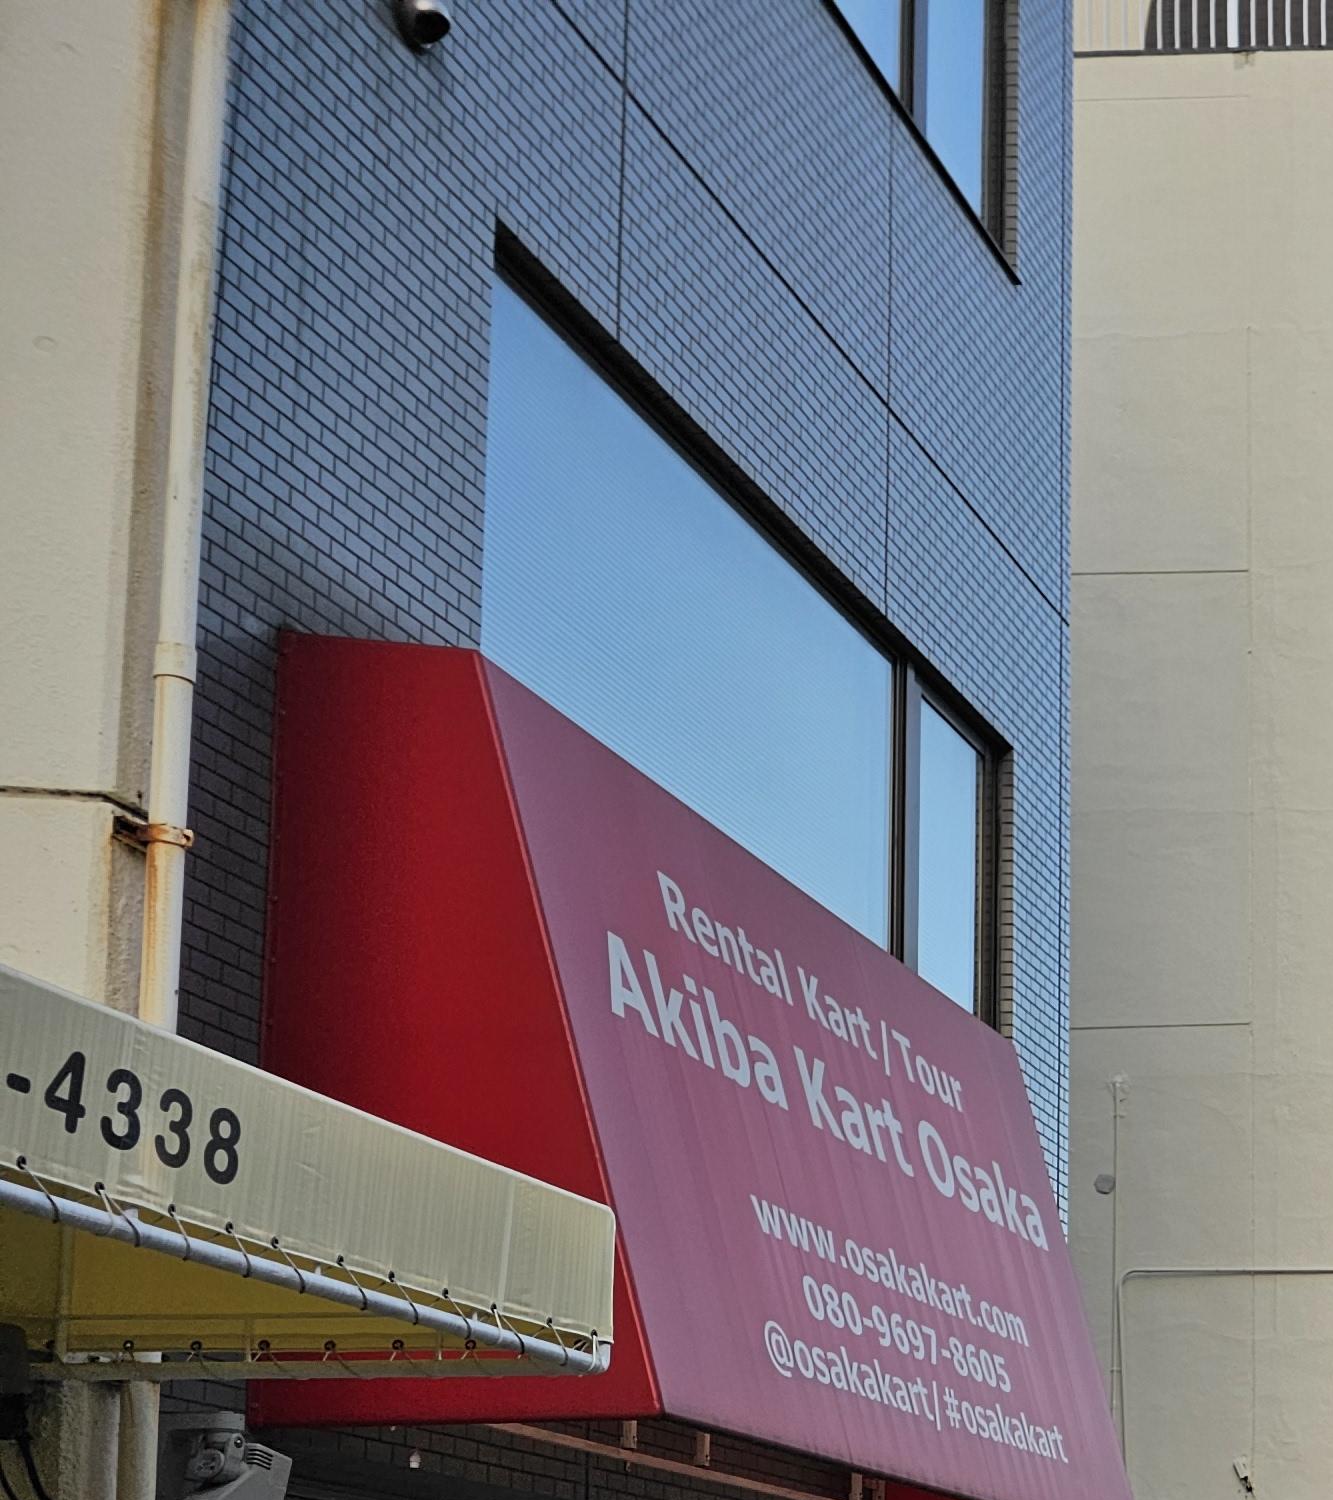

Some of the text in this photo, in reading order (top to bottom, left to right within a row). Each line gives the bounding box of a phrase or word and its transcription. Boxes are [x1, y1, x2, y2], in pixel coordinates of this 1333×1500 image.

[657, 870, 793, 1006] Rental
[797, 965, 878, 1060] Kart
[891, 1029, 964, 1112] Tour
[7, 1051, 241, 1185] -4338
[607, 930, 1049, 1252] Akiba Kart Osaka
[750, 1194, 1030, 1347] www.osakakart.com
[802, 1275, 1011, 1393] 080-9697-8605
